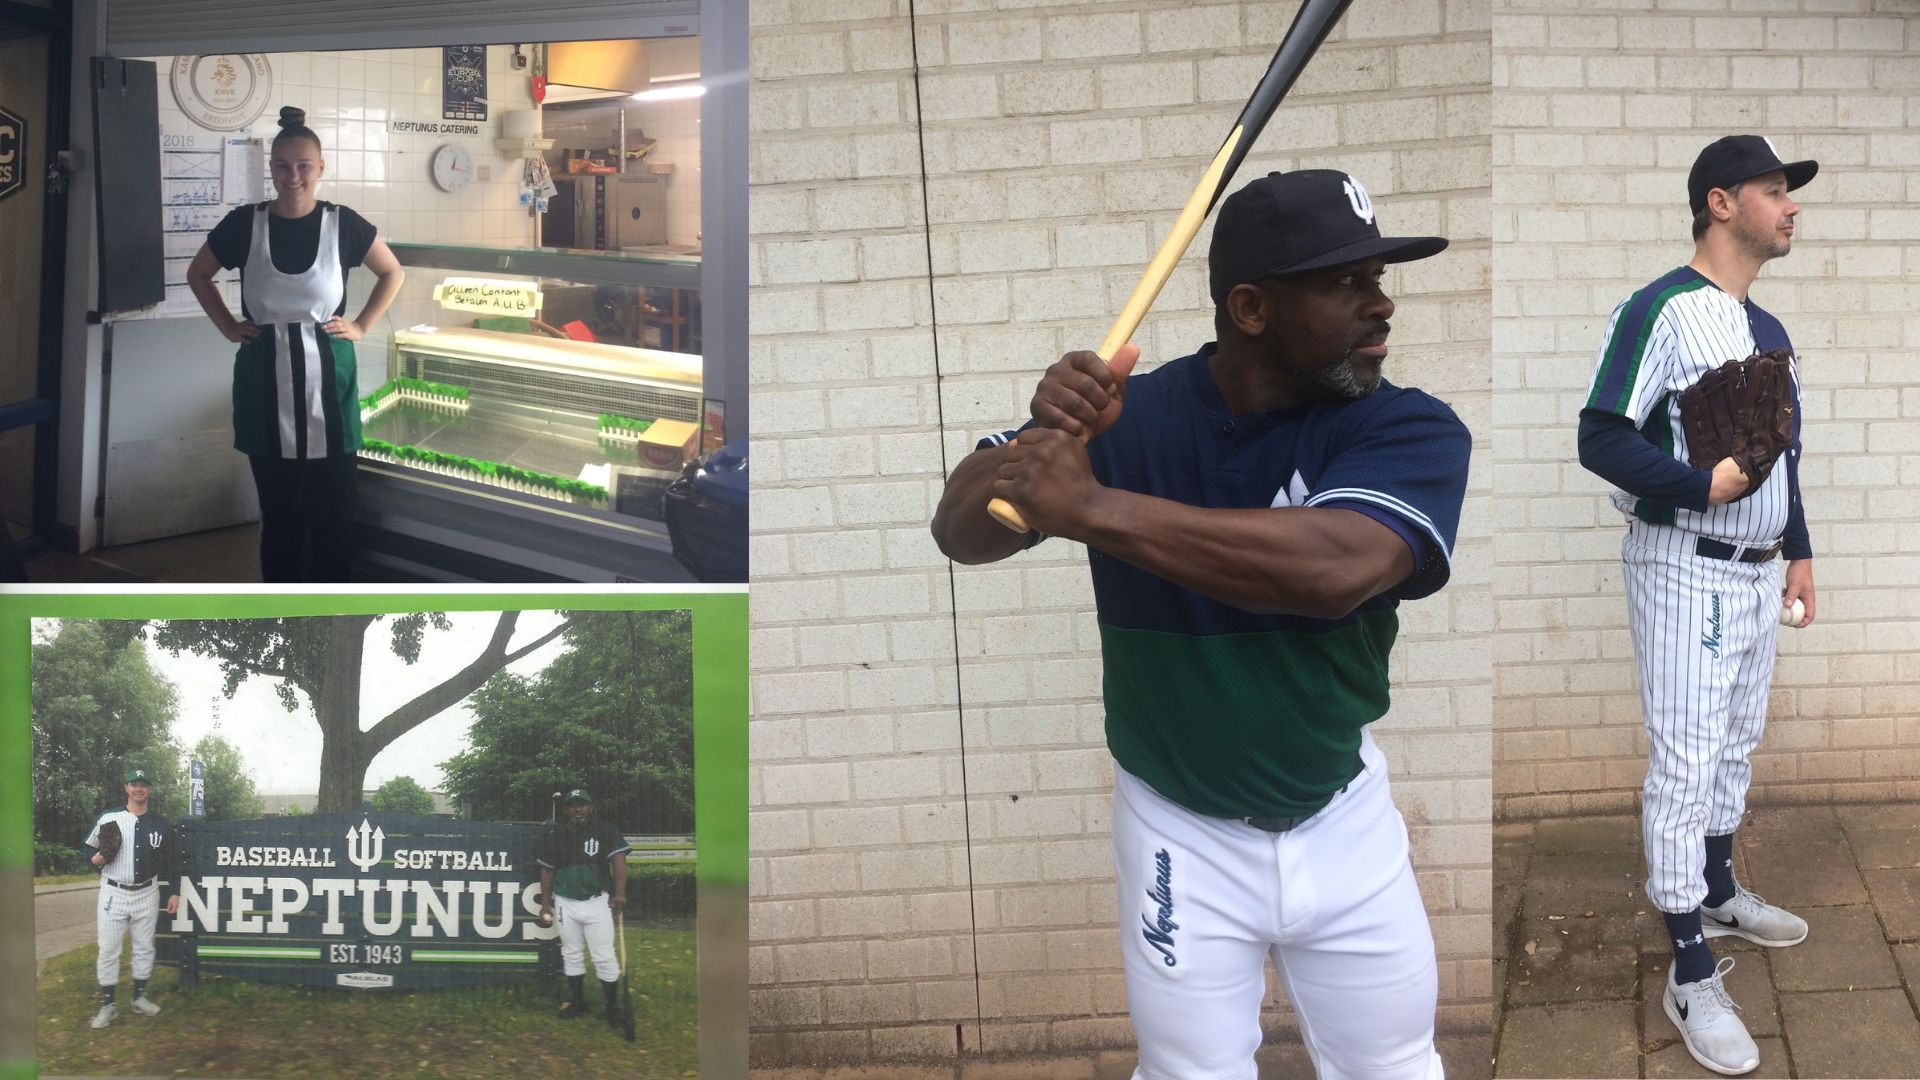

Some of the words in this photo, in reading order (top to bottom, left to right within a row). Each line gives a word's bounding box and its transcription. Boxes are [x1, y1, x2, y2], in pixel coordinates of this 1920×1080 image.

[448, 69, 482, 78] EUROPA
[393, 122, 438, 133] NEPTUNUS
[440, 124, 479, 135] CATERING
[163, 134, 194, 147] 2018
[1701, 592, 1722, 659] Neptunus
[216, 846, 336, 868] BASEBALL
[394, 849, 513, 872] SOFTBALL
[171, 875, 562, 941] NEPTUNUS
[1141, 848, 1180, 968] Neptunus
[329, 944, 360, 964] EST.
[363, 944, 403, 965] 1943
